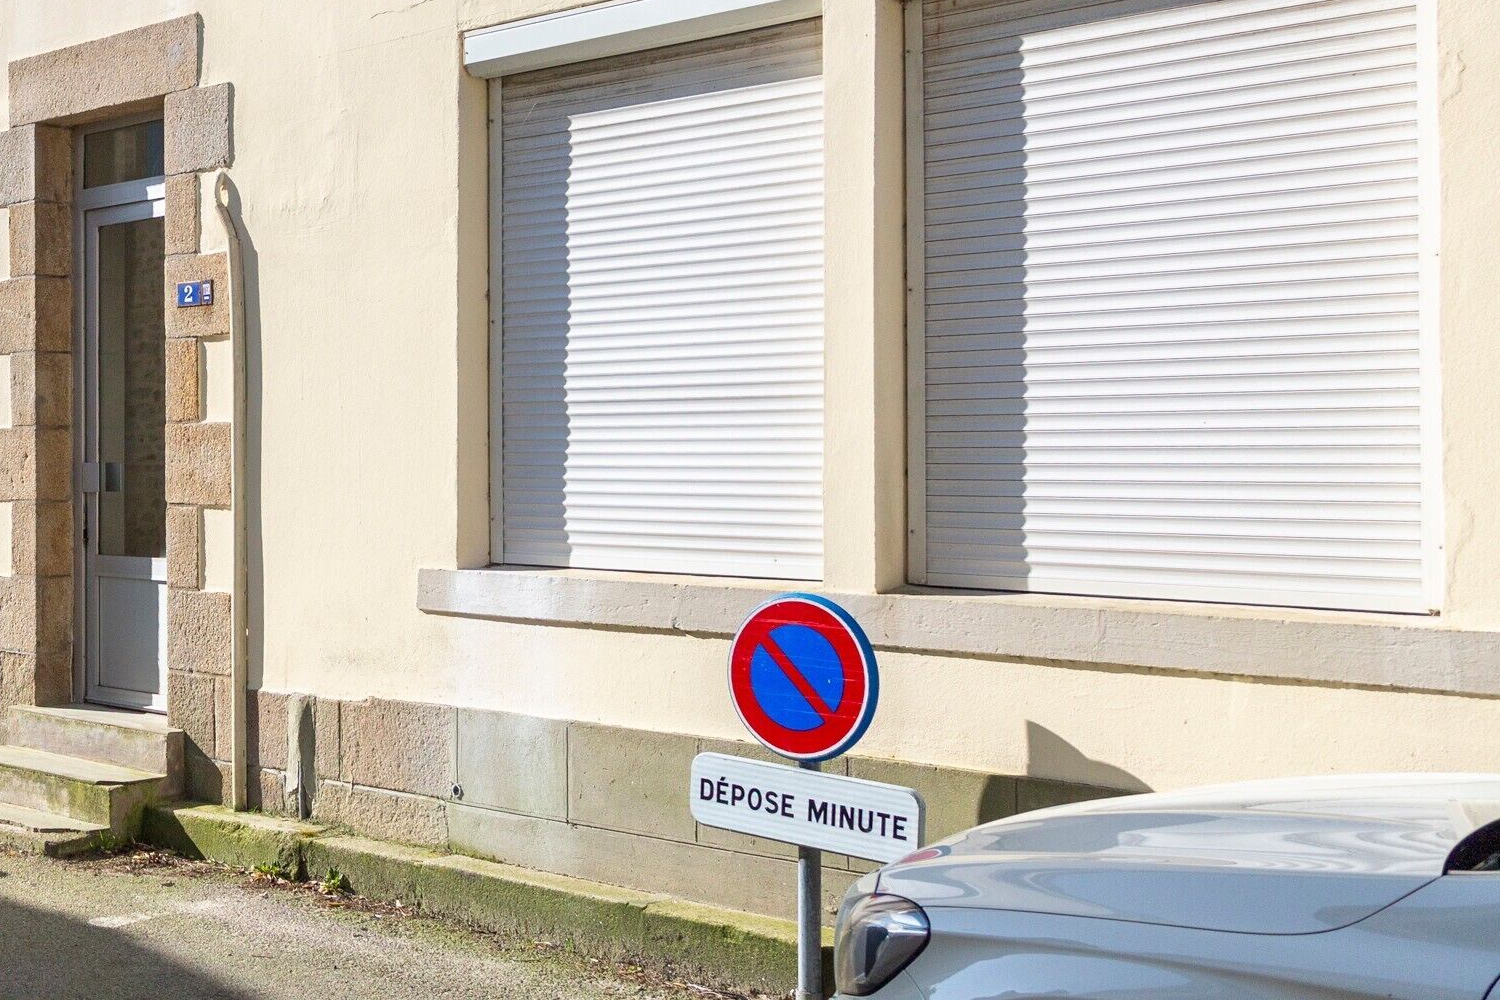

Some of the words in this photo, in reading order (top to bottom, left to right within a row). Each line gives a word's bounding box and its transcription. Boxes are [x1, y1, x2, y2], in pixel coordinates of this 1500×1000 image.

[184, 285, 193, 302] 2
[700, 776, 795, 819] DÉPOSE
[807, 799, 908, 841] MINUTE
